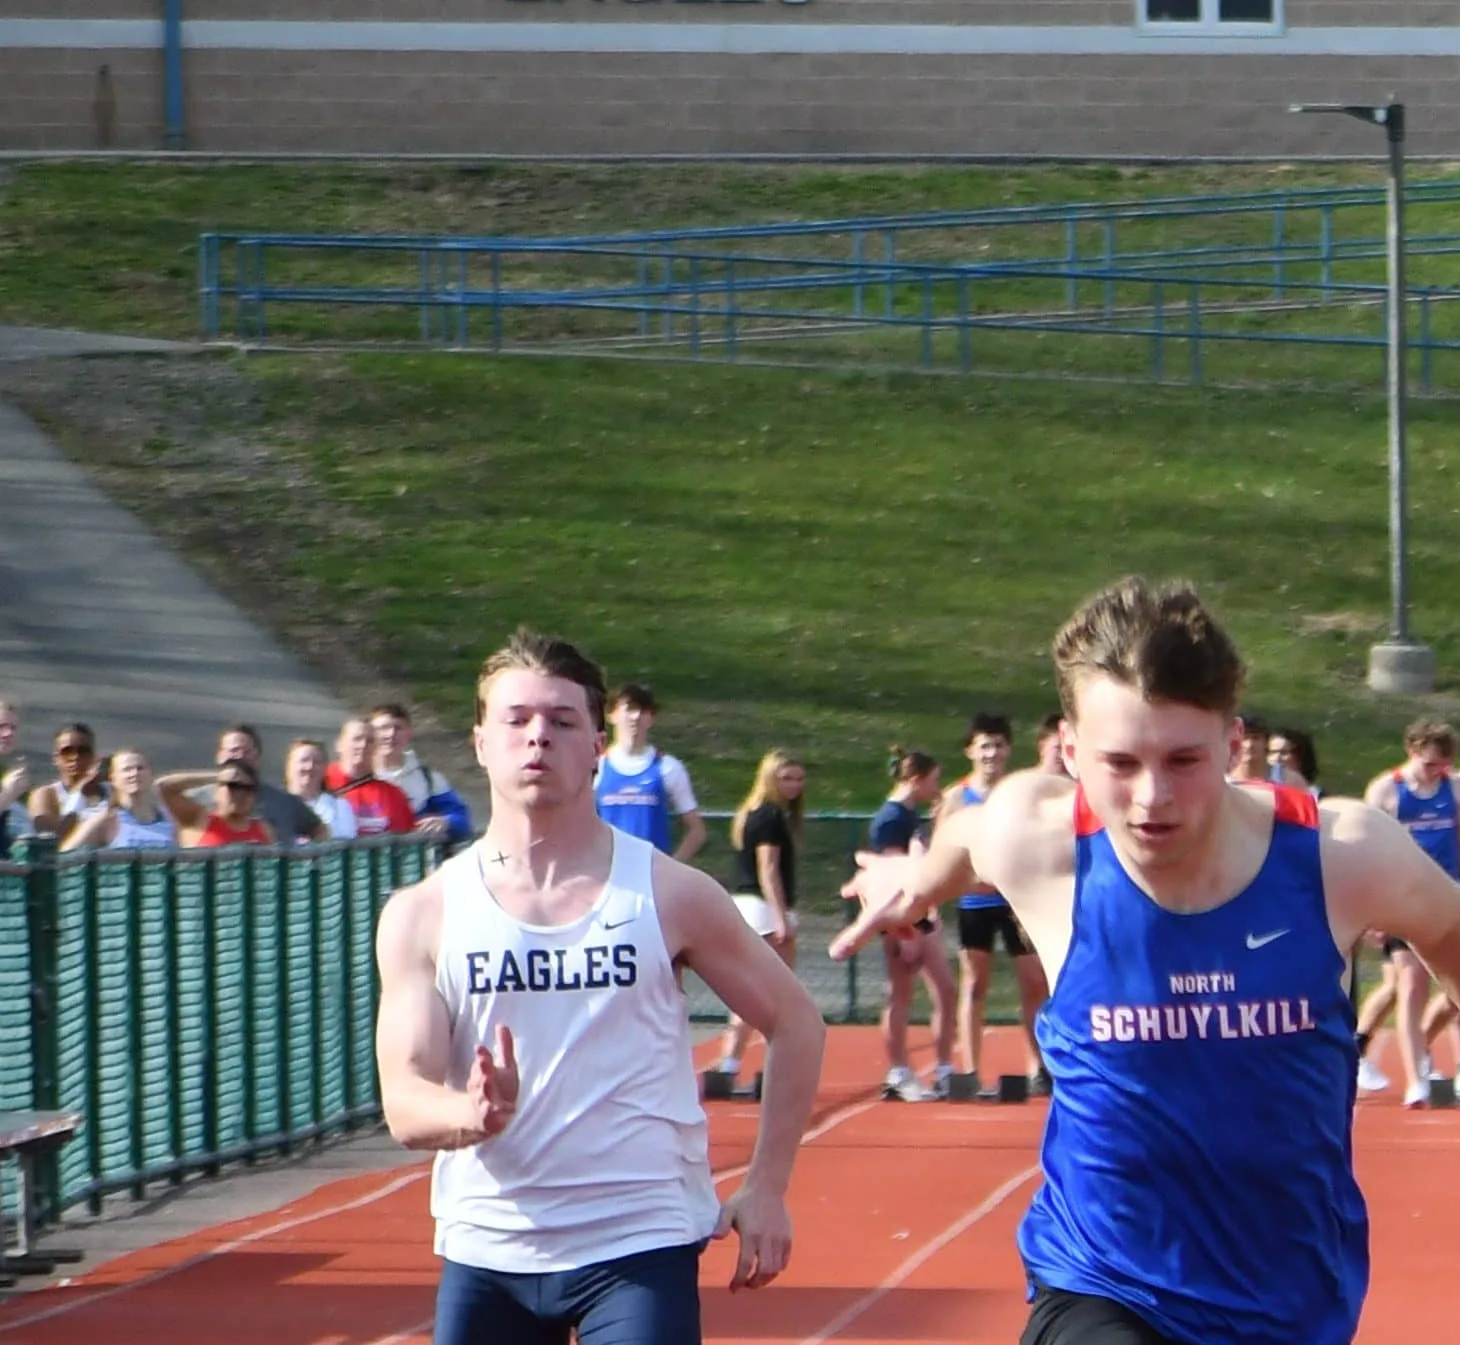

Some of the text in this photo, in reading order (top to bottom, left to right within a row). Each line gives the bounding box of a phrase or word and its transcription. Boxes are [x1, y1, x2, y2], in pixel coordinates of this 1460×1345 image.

[466, 944, 637, 994] EAGLES
[1168, 972, 1236, 994] NORTH
[1089, 998, 1316, 1042] SCHUYLKILL
